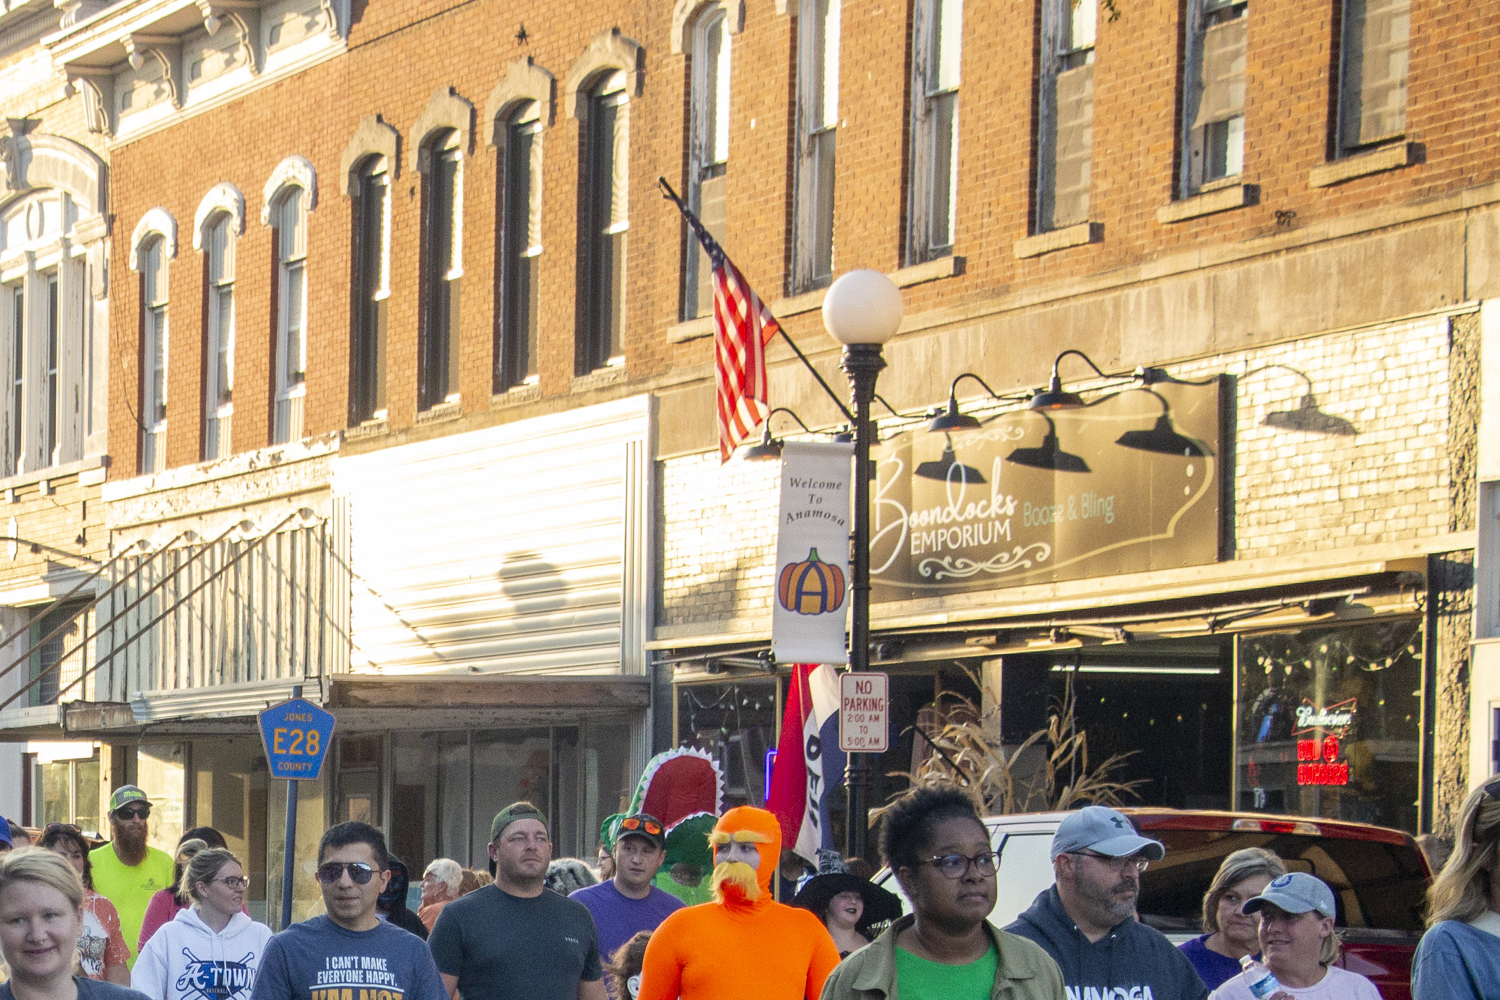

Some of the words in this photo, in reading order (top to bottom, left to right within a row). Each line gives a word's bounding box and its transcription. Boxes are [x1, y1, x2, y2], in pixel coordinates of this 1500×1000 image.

[789, 477, 843, 490] Welcome
[808, 493, 823, 504] To
[869, 456, 1018, 574] Boondocks
[1023, 501, 1064, 528] Booze
[1067, 495, 1077, 521] &
[1080, 491, 1115, 524] Bling
[785, 509, 846, 527] Anamosa
[910, 518, 1013, 556] EMPORIUM
[855, 680, 873, 695] NO
[844, 697, 884, 713] PARKING
[284, 713, 314, 723] JONES
[847, 714, 866, 723] 2:00
[868, 714, 880, 723] AM
[859, 725, 868, 734] TO
[273, 727, 320, 756] E28
[847, 737, 866, 747] 5:00
[868, 737, 880, 746] AM
[277, 761, 313, 772] COUNTY
[1297, 762, 1349, 786] BURGERS
[325, 956, 330, 970] I
[331, 956, 360, 970] CAN'T
[361, 956, 387, 971] MAKE
[316, 969, 365, 985] EVERYONE
[366, 971, 398, 987] HAPPY.
